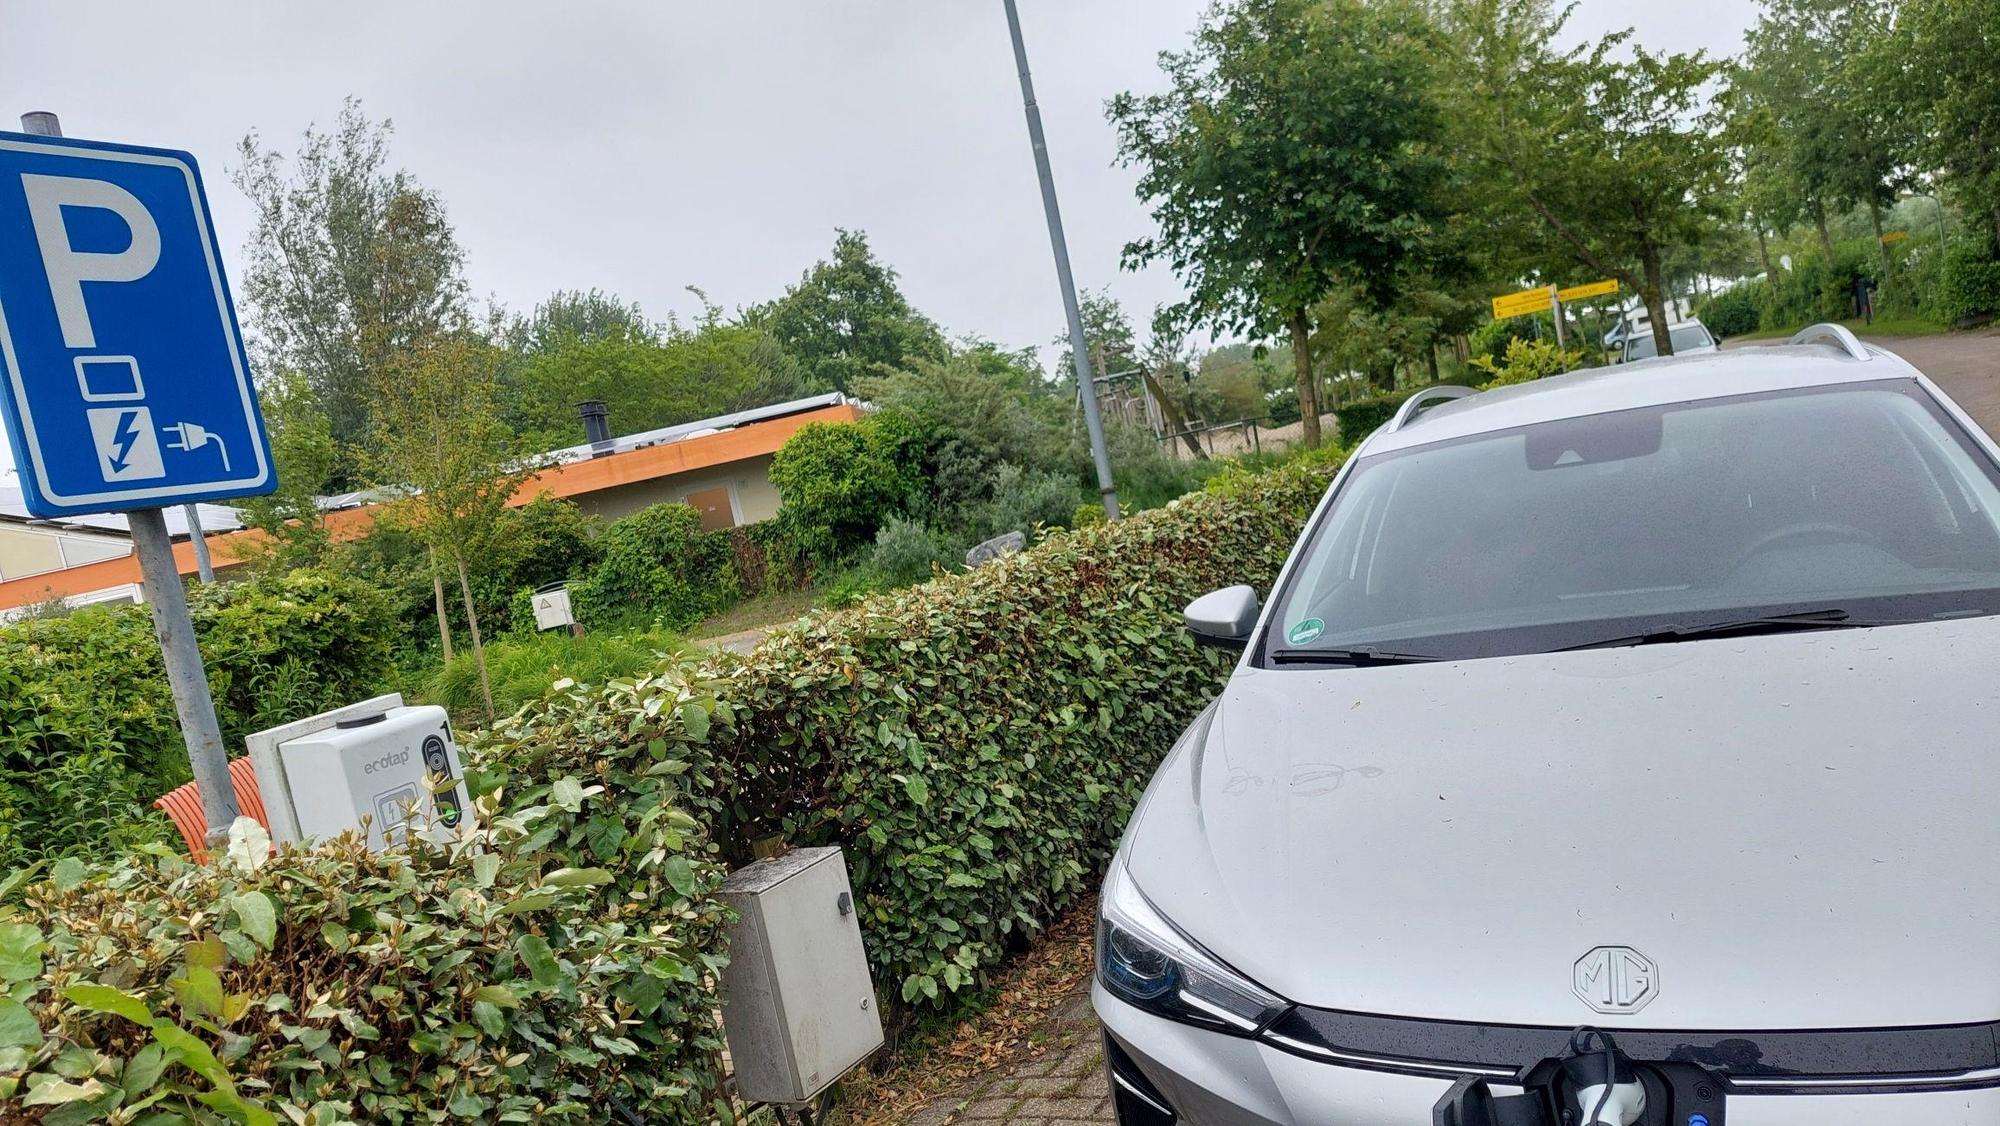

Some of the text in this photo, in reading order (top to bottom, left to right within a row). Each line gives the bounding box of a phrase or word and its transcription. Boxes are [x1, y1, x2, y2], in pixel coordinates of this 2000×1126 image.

[21, 173, 161, 348] P
[440, 720, 452, 742] 1
[364, 748, 409, 775] ecotap
[1579, 949, 1649, 1006] MG
